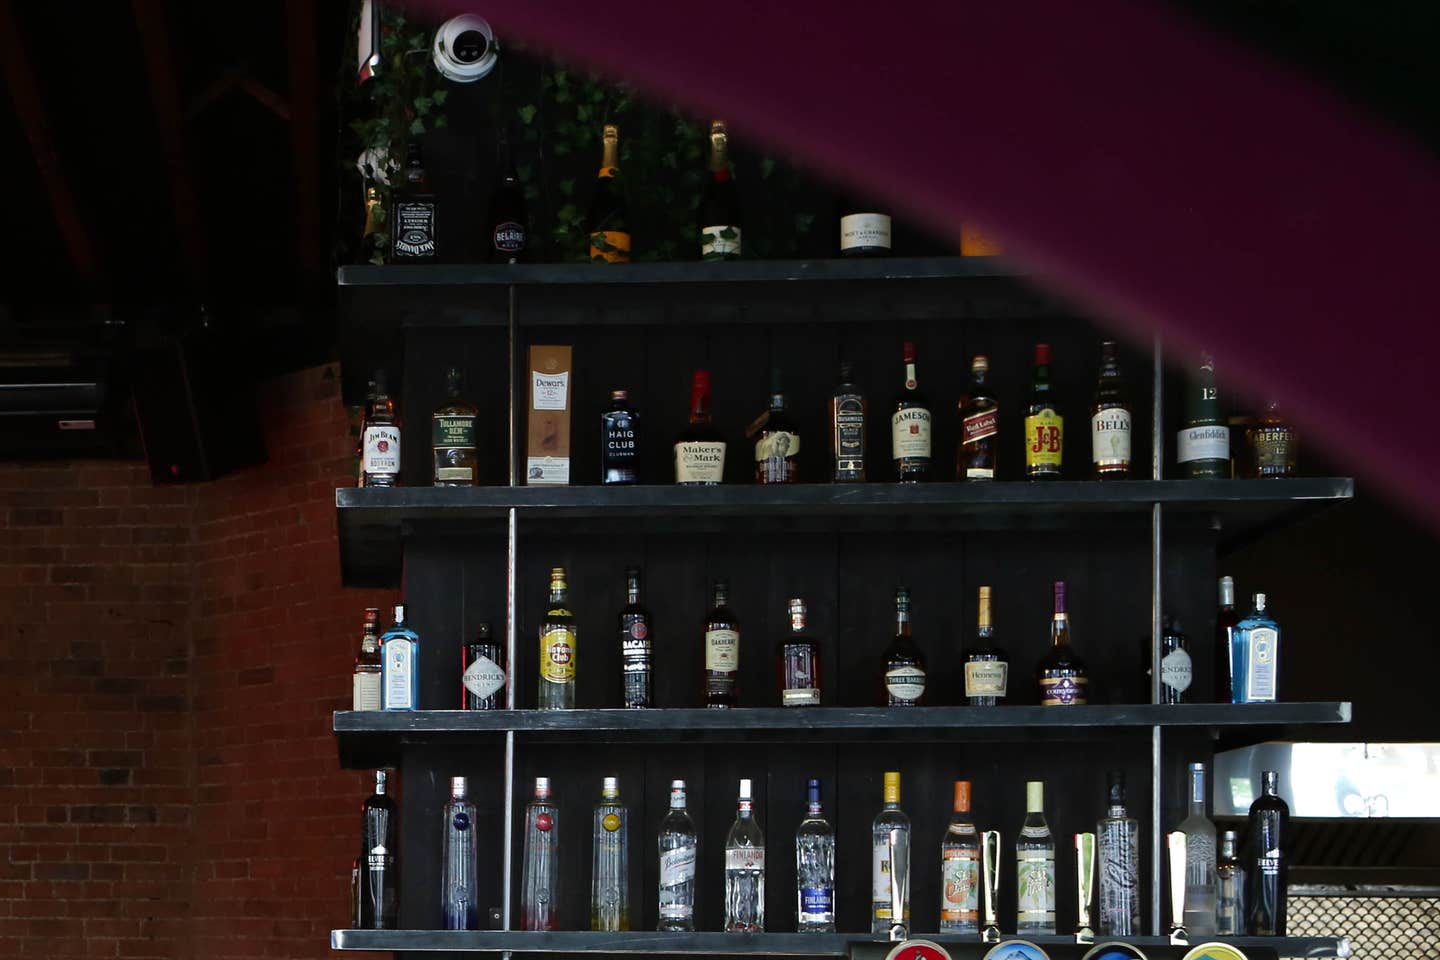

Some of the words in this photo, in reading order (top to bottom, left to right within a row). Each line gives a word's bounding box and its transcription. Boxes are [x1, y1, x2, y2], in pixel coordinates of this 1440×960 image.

[1203, 387, 1217, 400] 12
[368, 432, 380, 444] JIM
[608, 430, 635, 439] HAIG
[608, 440, 636, 449] CLUB
[694, 453, 721, 462] Mark
